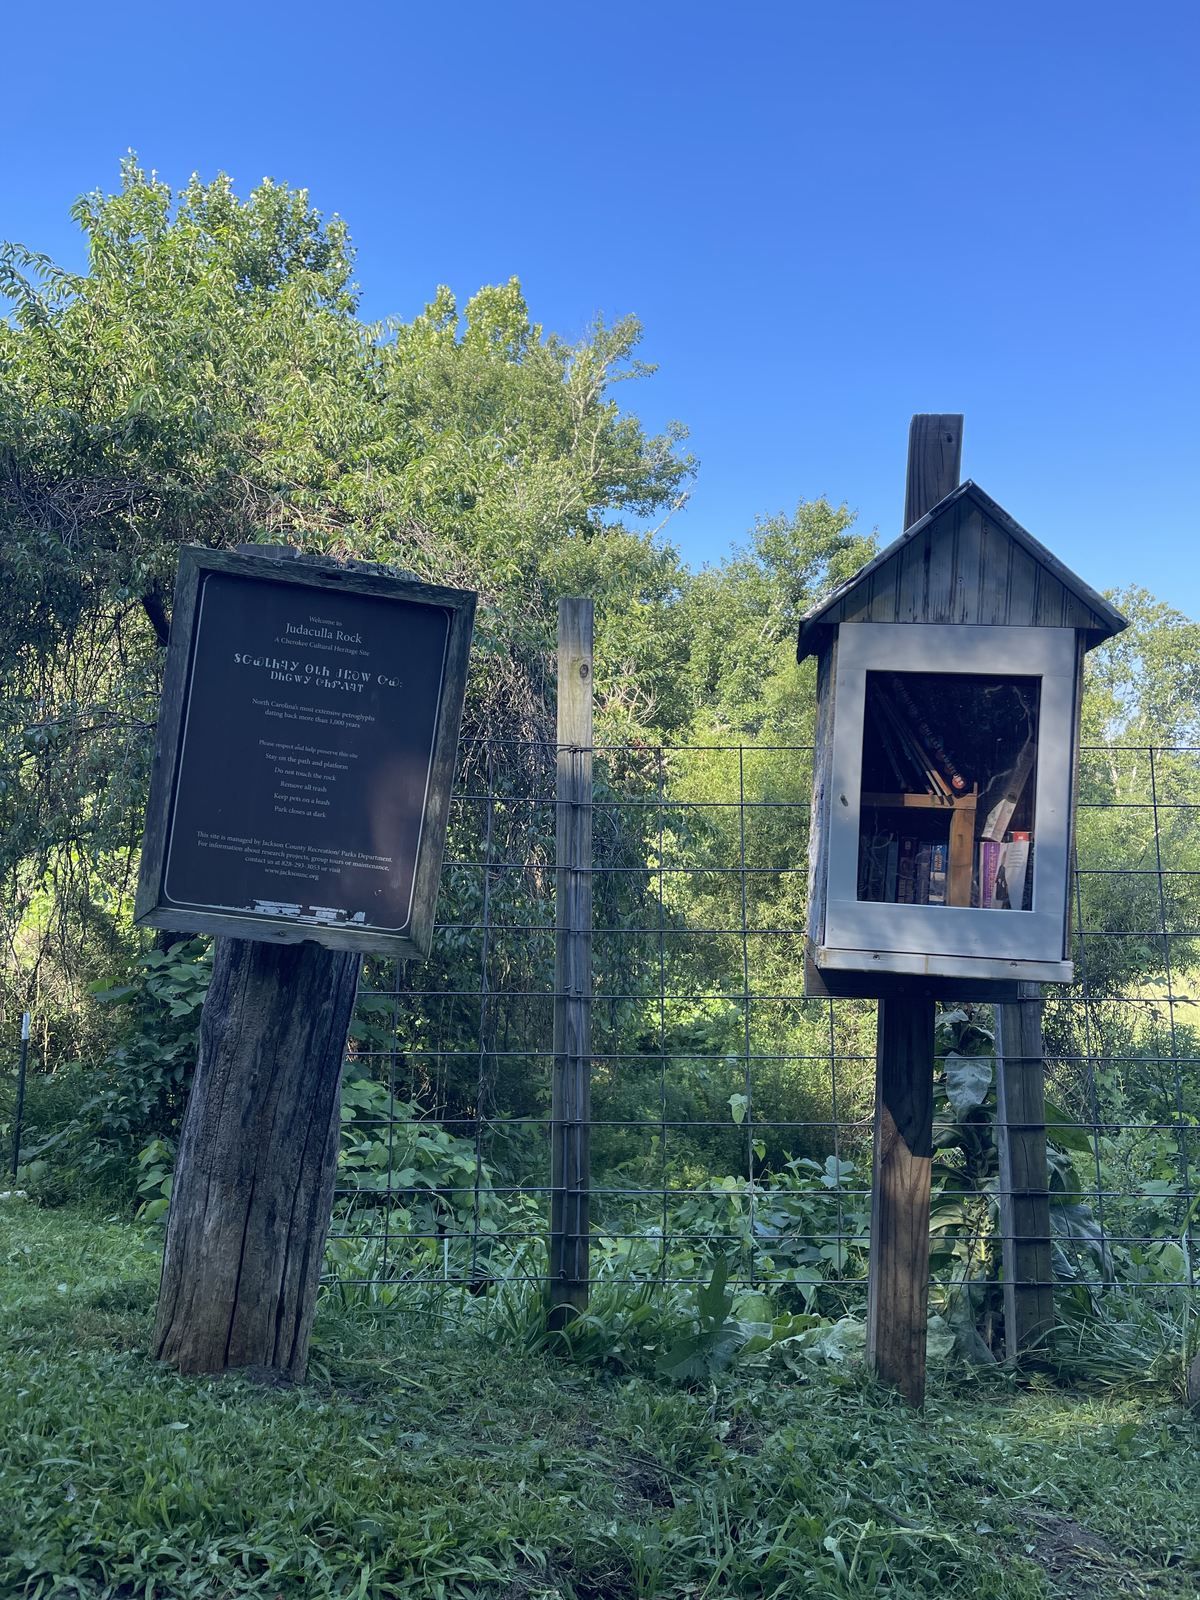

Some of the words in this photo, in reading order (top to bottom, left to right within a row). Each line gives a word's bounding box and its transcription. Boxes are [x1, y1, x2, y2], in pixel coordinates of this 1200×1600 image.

[309, 616, 336, 626] Welcome
[286, 622, 333, 640] Judaculla
[336, 629, 362, 644] Rock
[281, 637, 308, 647] Cherokee
[309, 641, 333, 651] Cultural
[334, 645, 359, 656] Heritage
[252, 698, 269, 706] North
[270, 701, 298, 711] Carolina's
[299, 705, 314, 713] most
[314, 707, 341, 717] extensive
[341, 711, 375, 723] petroglyphs
[264, 709, 283, 718] dating
[284, 712, 298, 720] back
[315, 716, 328, 724] than
[345, 721, 360, 730] years
[259, 739, 274, 747] Please
[275, 742, 294, 751] respect
[305, 746, 316, 754] help
[317, 748, 338, 757] preserve
[338, 750, 349, 758] this
[265, 753, 276, 761] Stay
[297, 757, 311, 766] path
[323, 760, 348, 771] platform
[295, 770, 312, 778] touch
[280, 780, 303, 790] Remove
[312, 785, 327, 793] trash
[273, 792, 288, 801] Keep
[289, 795, 301, 803] pets
[315, 798, 330, 806] leash
[274, 805, 288, 813] Park
[288, 807, 305, 815] closes
[313, 810, 326, 818] dark
[197, 830, 208, 838] This
[227, 835, 253, 845] managed
[262, 839, 284, 849] Jackson
[285, 842, 306, 852] County
[342, 850, 357, 858] Parks
[209, 841, 243, 852] information
[244, 846, 261, 854] about
[262, 849, 285, 858] research
[311, 856, 329, 865] group
[244, 856, 266, 864] contact
